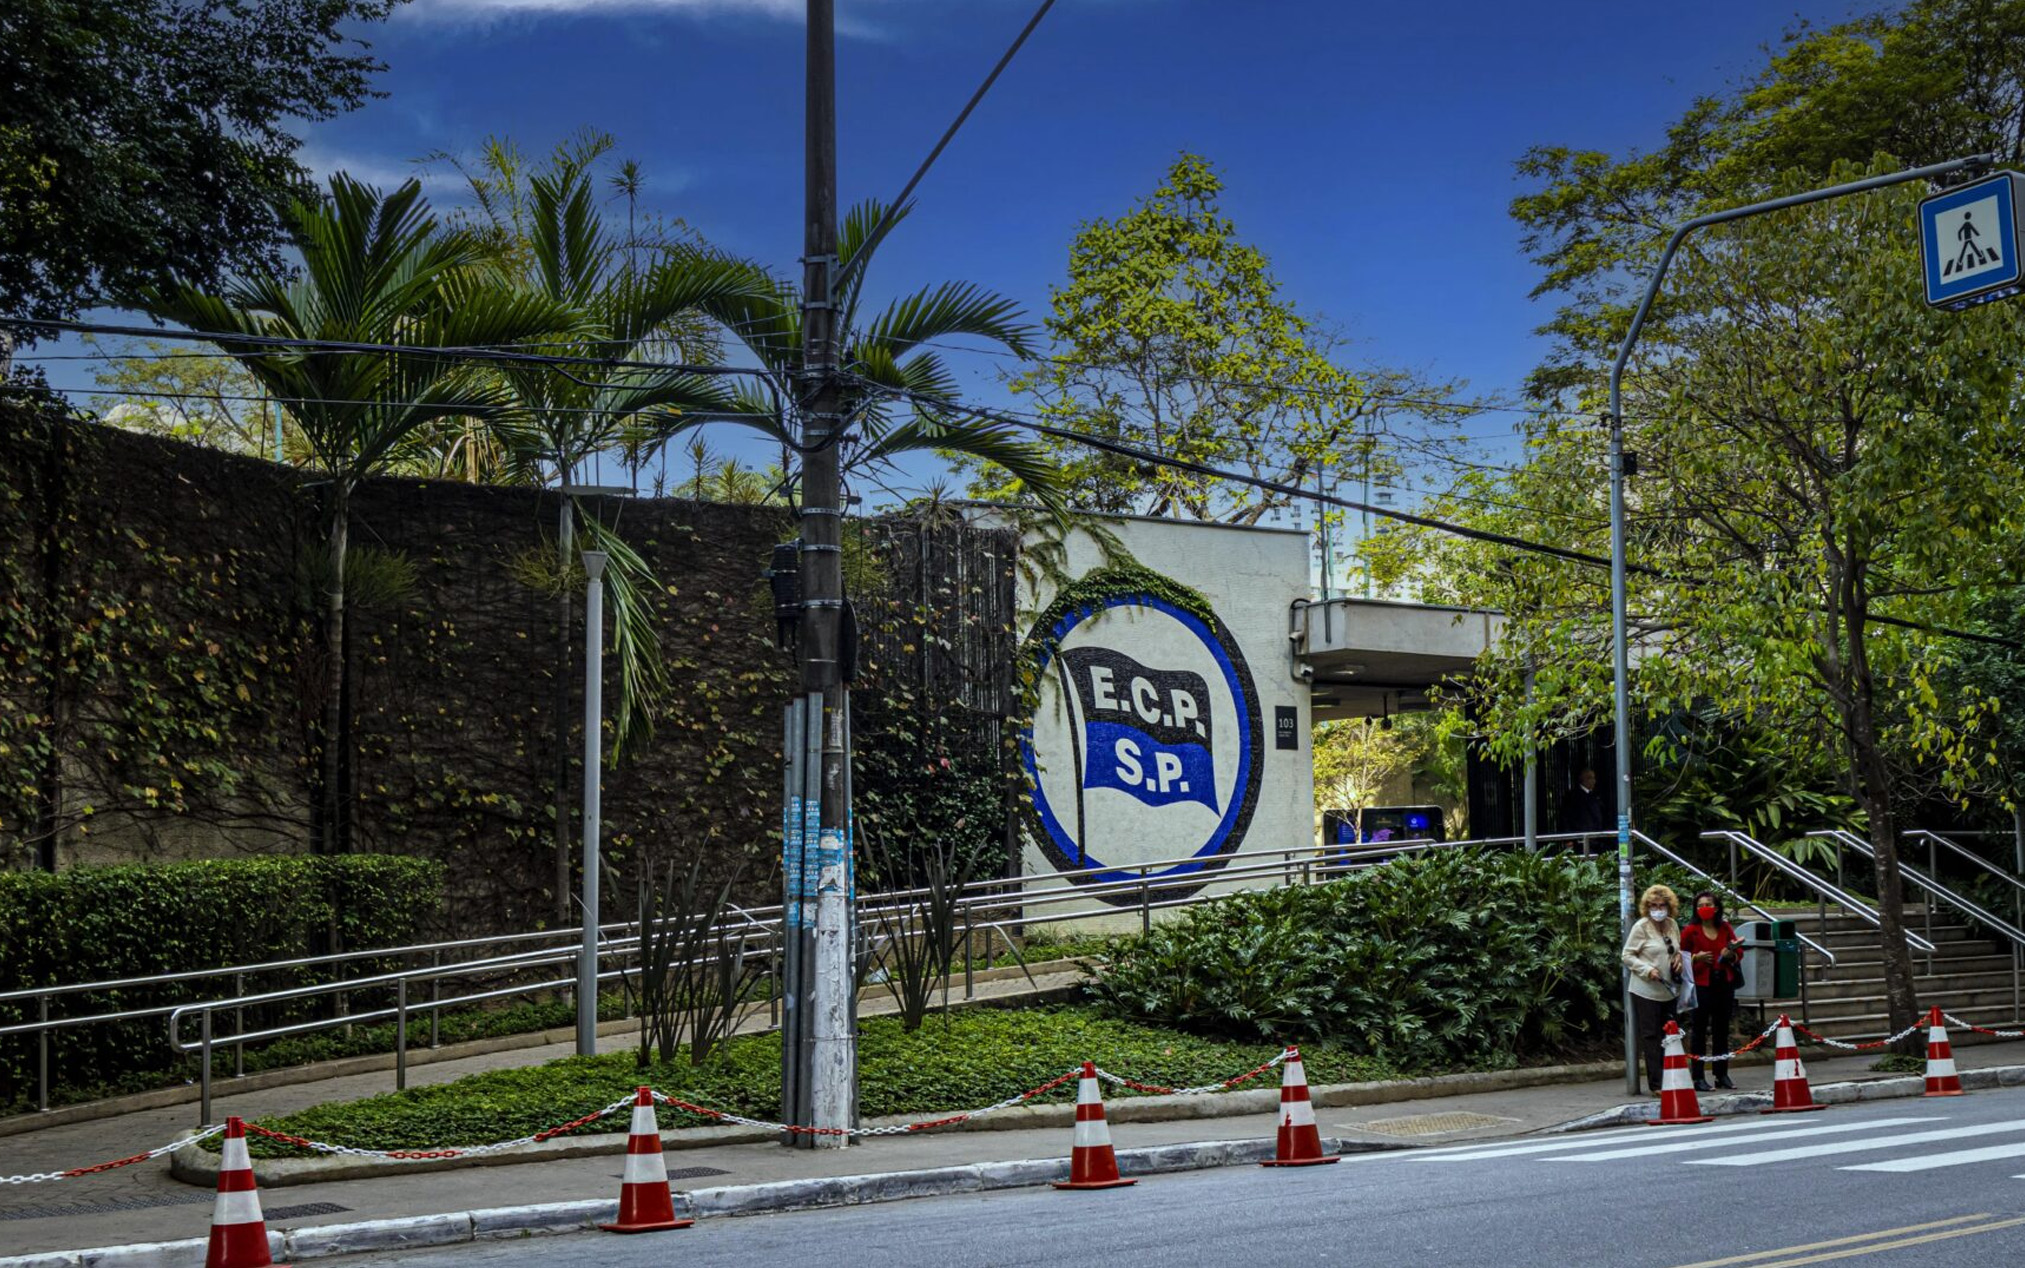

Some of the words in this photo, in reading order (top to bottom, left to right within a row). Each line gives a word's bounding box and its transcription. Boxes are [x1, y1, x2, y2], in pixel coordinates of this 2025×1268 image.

[1090, 666, 1206, 738] E.C.P.
[1279, 718, 1294, 728] 103
[1115, 738, 1190, 792] S.P.
